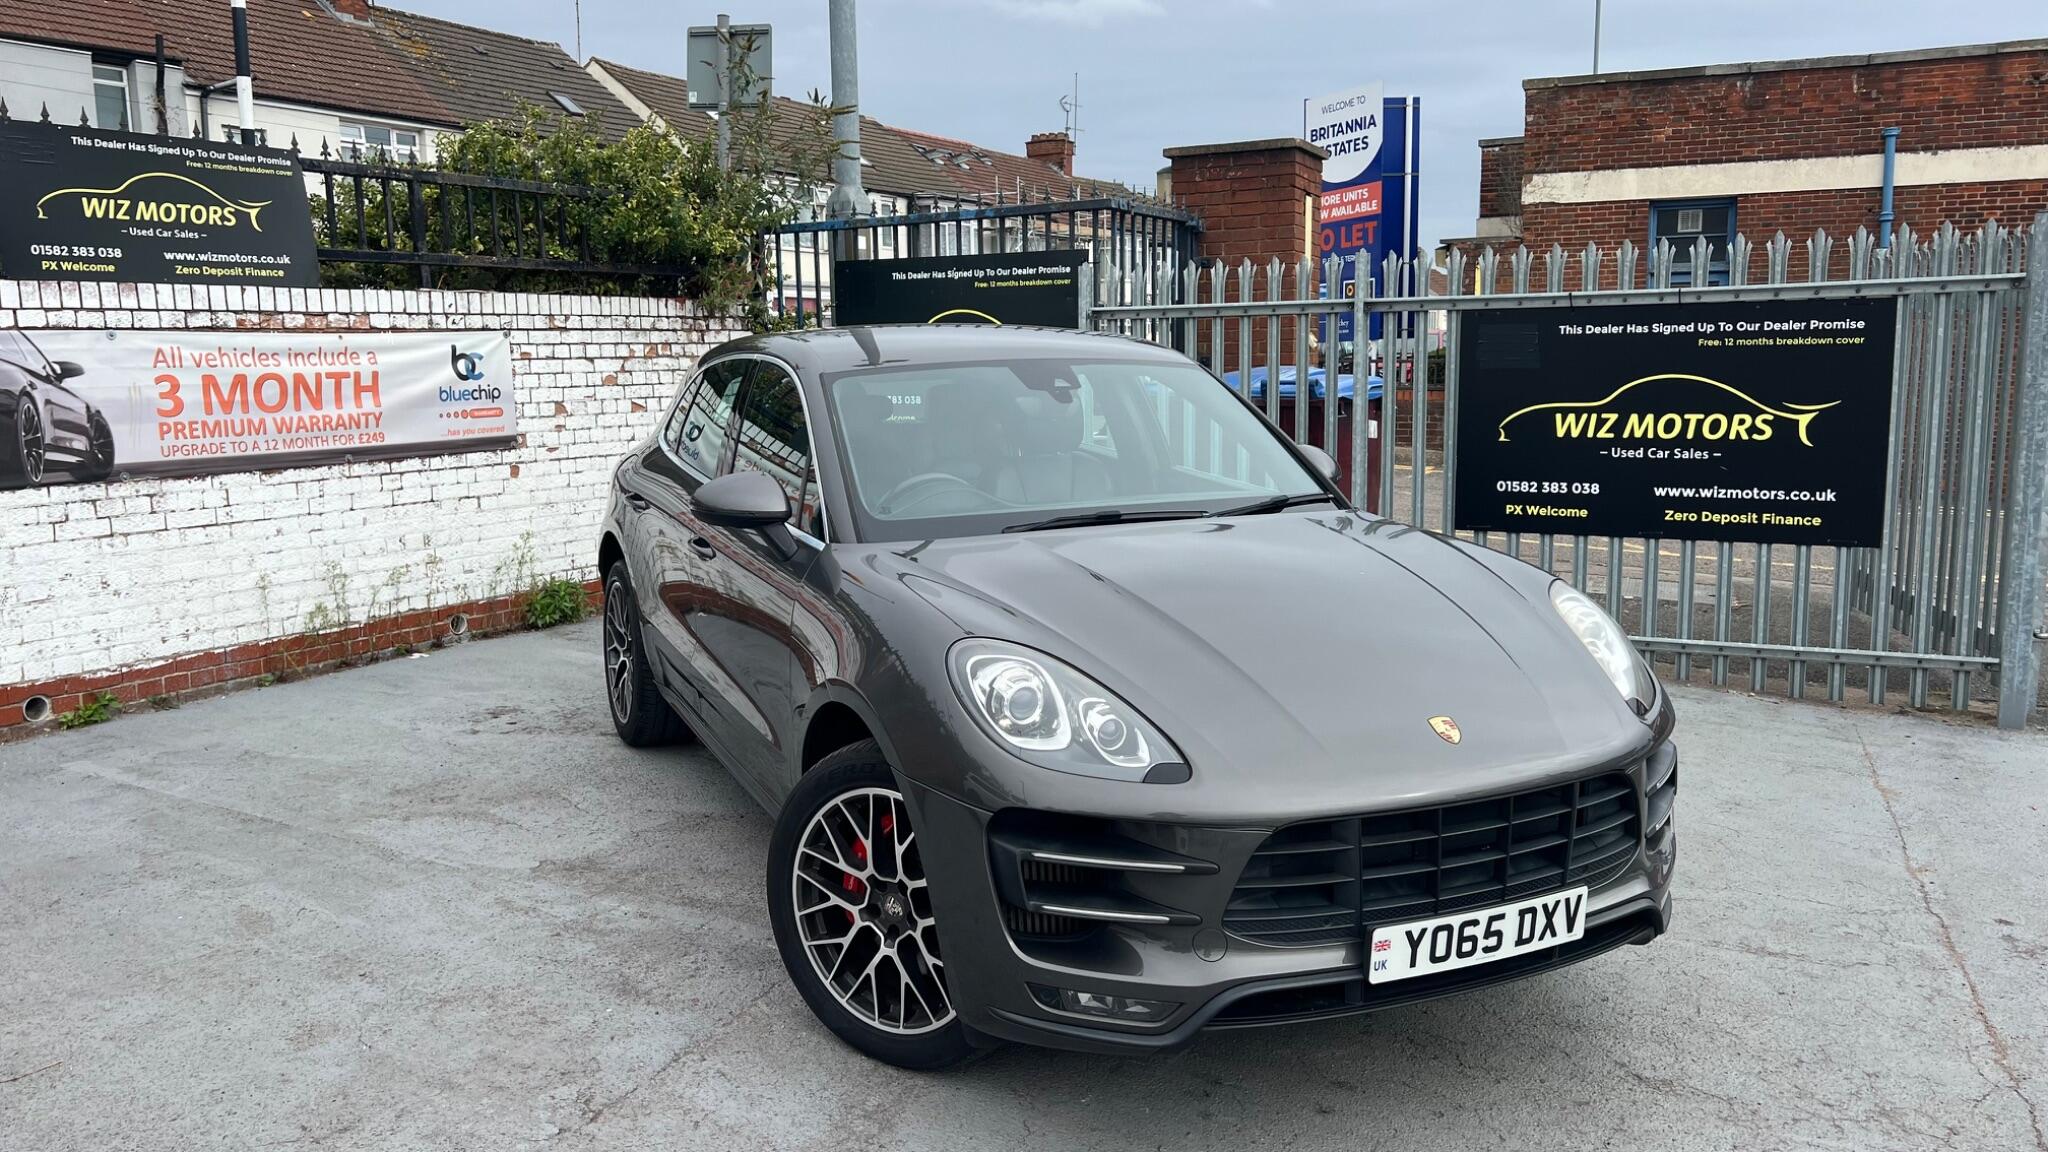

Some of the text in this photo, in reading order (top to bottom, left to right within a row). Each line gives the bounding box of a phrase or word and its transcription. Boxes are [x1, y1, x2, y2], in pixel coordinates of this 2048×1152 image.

[1321, 95, 1366, 114] WELCOME TO
[1310, 114, 1377, 142] BRITANNIA
[70, 136, 291, 166] This Dealer Has Signed Up To Our Dealer Promise
[1320, 135, 1369, 158] STATES
[212, 164, 237, 172] months
[239, 165, 275, 175] breakdown
[1343, 188, 1369, 203] UNITS
[81, 197, 237, 227] WIZ MOTORS
[1330, 200, 1378, 218] AVAILABLE
[129, 227, 199, 239] Used Car Sales
[1320, 220, 1377, 250] O LET
[30, 244, 123, 258] 01582 383 038
[164, 252, 291, 264] www.wizmotors.co.uk
[41, 261, 116, 272] PX Welcome
[175, 265, 285, 277] Zero Deposit Finance
[891, 265, 1071, 280] This Dealer Has Signed Up To Our Dealer Promise
[1559, 318, 1866, 335] This Dealer Has Signed Up To Our Dealer Promise
[1724, 338, 1734, 346] 12
[1736, 337, 1774, 346] months
[1776, 336, 1833, 345] breakdown
[1836, 336, 1865, 344] cover
[152, 346, 378, 368] All vehicles include a
[154, 370, 382, 418] 3 MONTH
[439, 384, 501, 403] bluechip
[158, 411, 383, 440] PREMIUM WARRANTY
[1555, 412, 1775, 440] WIZ MOTORS
[160, 432, 385, 457] UPGRADE TO A 12 MONTH FOR £249
[1611, 447, 1709, 459] Used Car Sales
[1496, 480, 1600, 494] 01582 383 038
[1654, 486, 1837, 501] www.wizmotors.co.uk
[1505, 505, 1588, 517] PX Welcome
[1664, 510, 1822, 526] Zero Deposit Finance
[1405, 894, 1583, 968] YO65 DXV
[1373, 960, 1388, 971] UK
